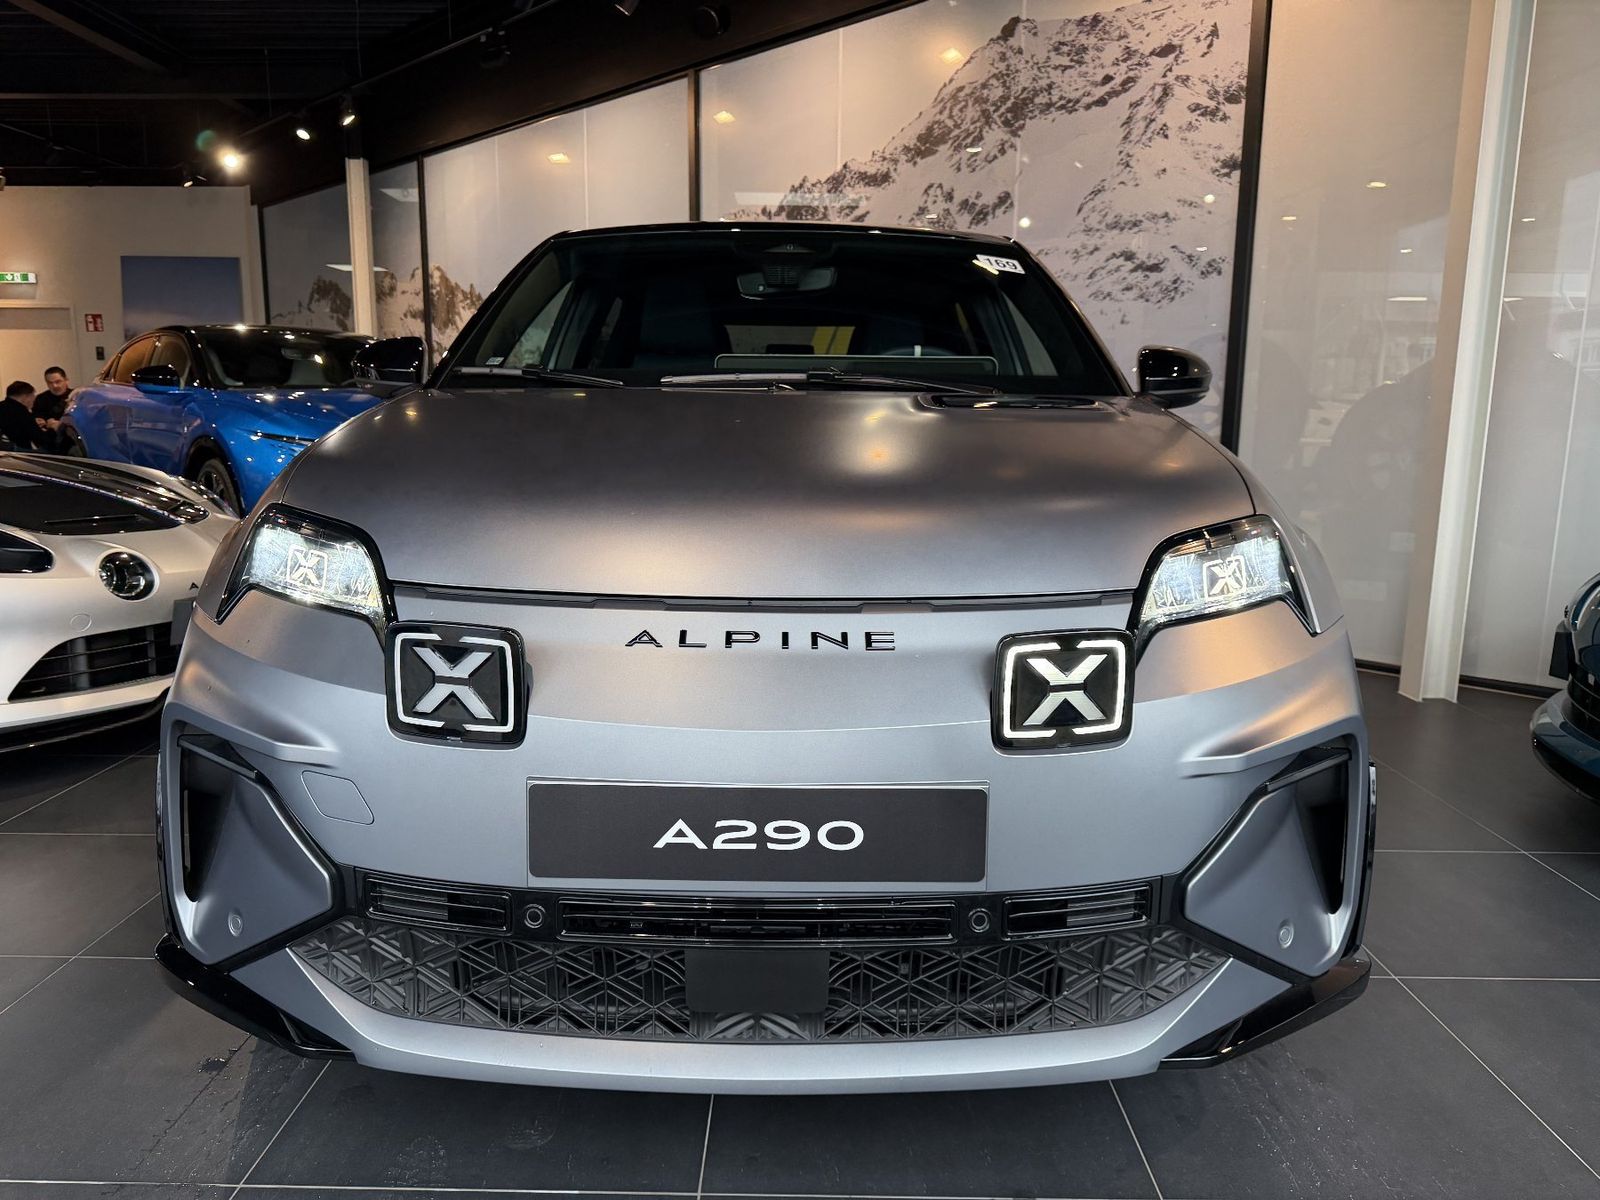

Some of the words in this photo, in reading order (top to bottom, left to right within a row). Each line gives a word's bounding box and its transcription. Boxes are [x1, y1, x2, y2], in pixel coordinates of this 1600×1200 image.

[983, 258, 1017, 270] 169
[624, 629, 896, 651] ALPINE
[652, 818, 865, 851] A290
